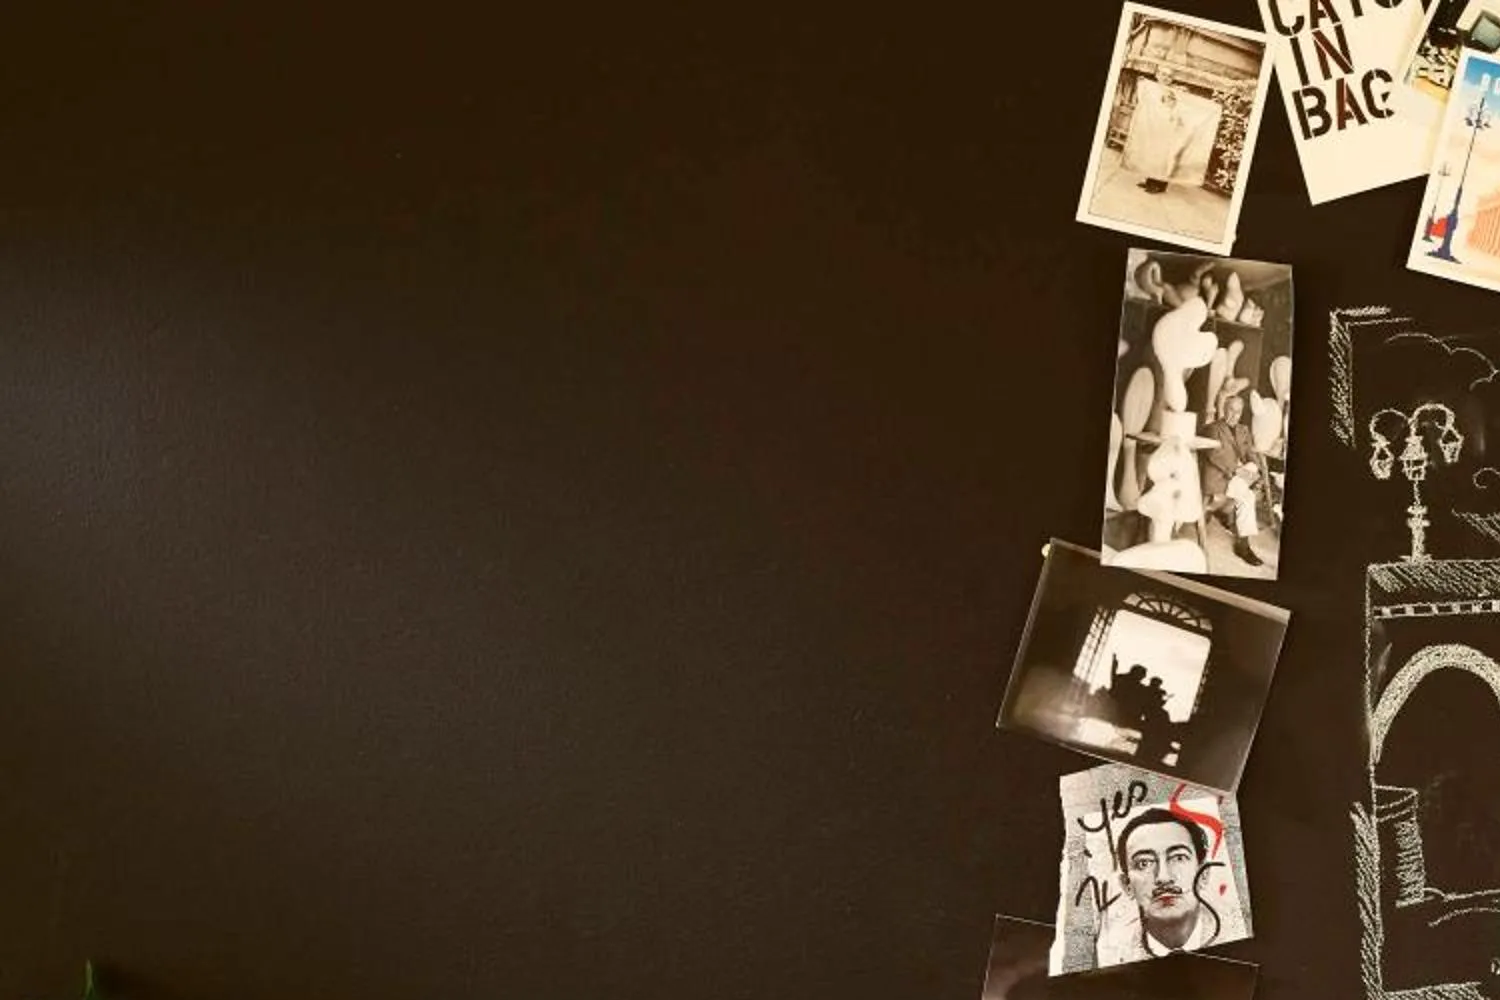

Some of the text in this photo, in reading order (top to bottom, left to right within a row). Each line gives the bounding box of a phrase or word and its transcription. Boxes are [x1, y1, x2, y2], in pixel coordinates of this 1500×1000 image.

[1268, 0, 1401, 36] CA
[1289, 24, 1354, 86] IN
[1292, 68, 1395, 141] BAG
